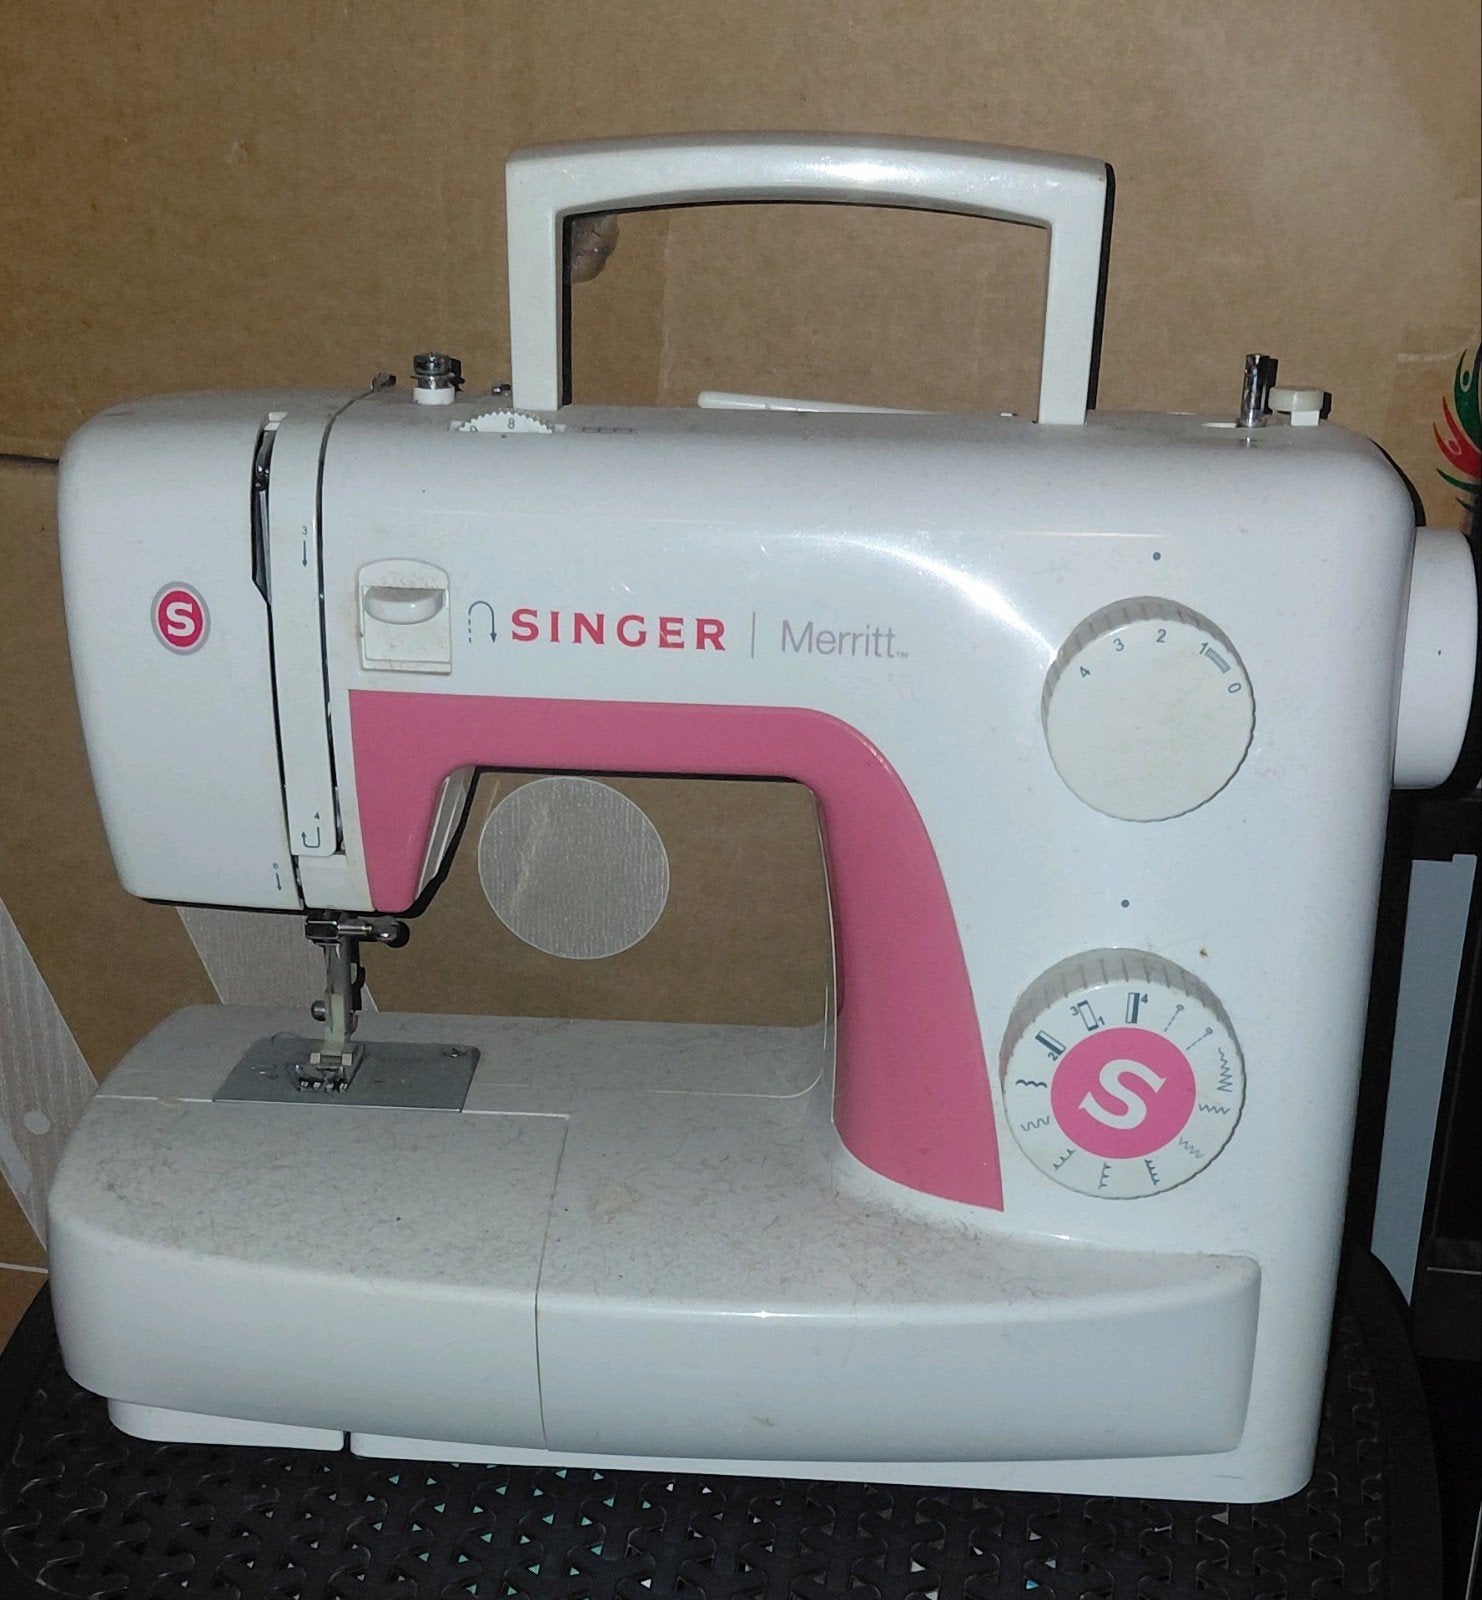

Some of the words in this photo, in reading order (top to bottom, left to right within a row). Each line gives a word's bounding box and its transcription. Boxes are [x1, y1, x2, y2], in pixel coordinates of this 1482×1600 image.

[508, 418, 515, 429] 8
[302, 525, 308, 536] 3
[165, 601, 196, 637] S
[511, 608, 726, 651] SINGER
[1080, 665, 1091, 678] 4
[1113, 637, 1125, 651] 3
[1156, 628, 1167, 643] 2
[1200, 641, 1209, 655] 1
[1228, 683, 1242, 694] 0
[1141, 993, 1149, 1004] 4
[1070, 1005, 1079, 1016] 3
[1098, 1016, 1106, 1026] 1
[1047, 1052, 1058, 1062] 2
[1077, 1059, 1167, 1130] S
